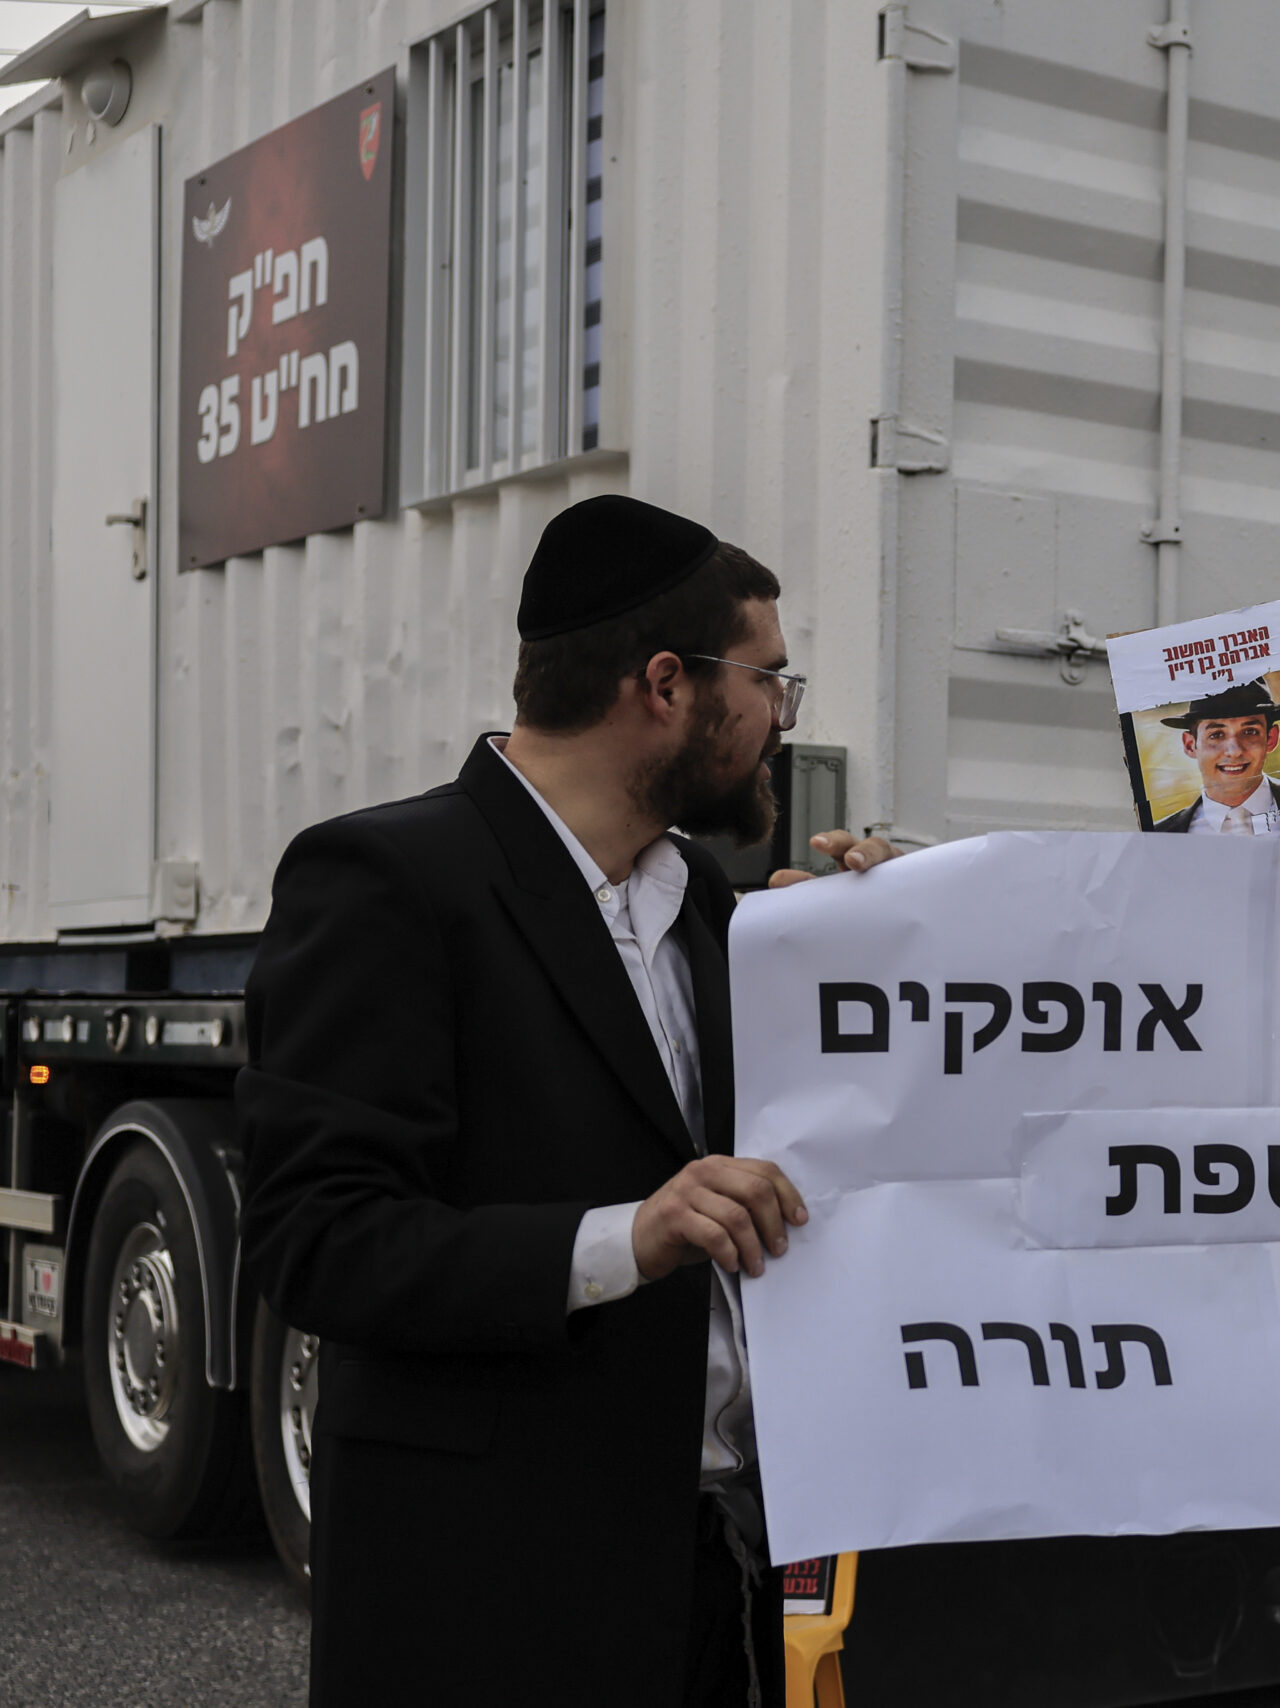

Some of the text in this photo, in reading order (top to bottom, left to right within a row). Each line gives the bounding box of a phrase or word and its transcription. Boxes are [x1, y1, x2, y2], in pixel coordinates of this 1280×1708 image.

[227, 236, 329, 358] חפ"ק
[197, 340, 359, 464] מח"ט 35
[1162, 625, 1270, 663] האברך החשוב
[1167, 642, 1271, 681] אברהם בן דיין
[818, 980, 1203, 1075] אופקים
[900, 1321, 1173, 1390] תורה
